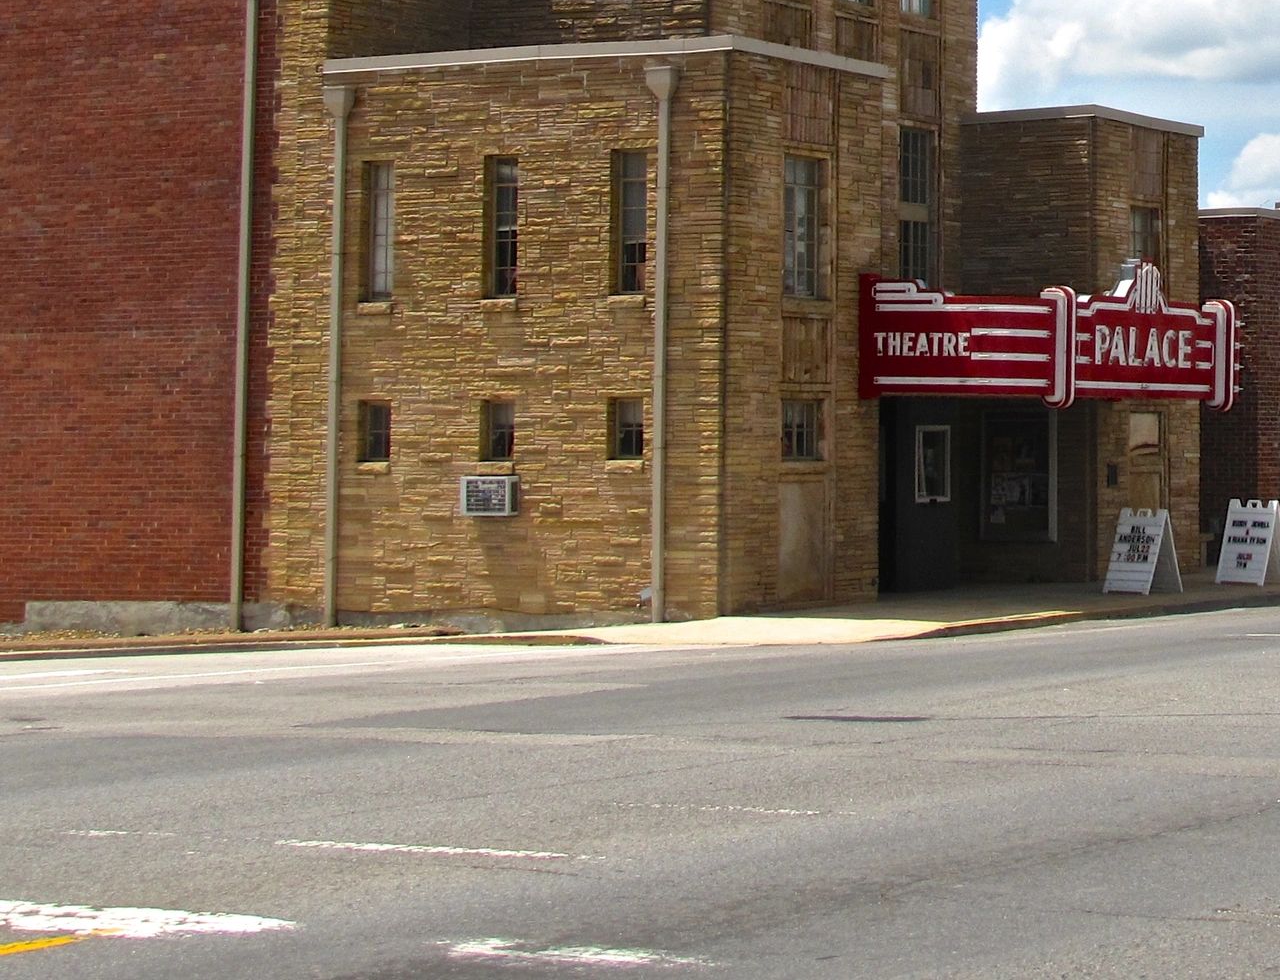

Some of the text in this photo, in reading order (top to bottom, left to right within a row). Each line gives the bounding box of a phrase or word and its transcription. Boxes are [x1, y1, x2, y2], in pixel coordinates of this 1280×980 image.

[873, 331, 970, 357] THEATRE
[1094, 324, 1192, 369] PALACE
[1131, 525, 1145, 534] BILL
[1119, 534, 1155, 543] ANDERSON
